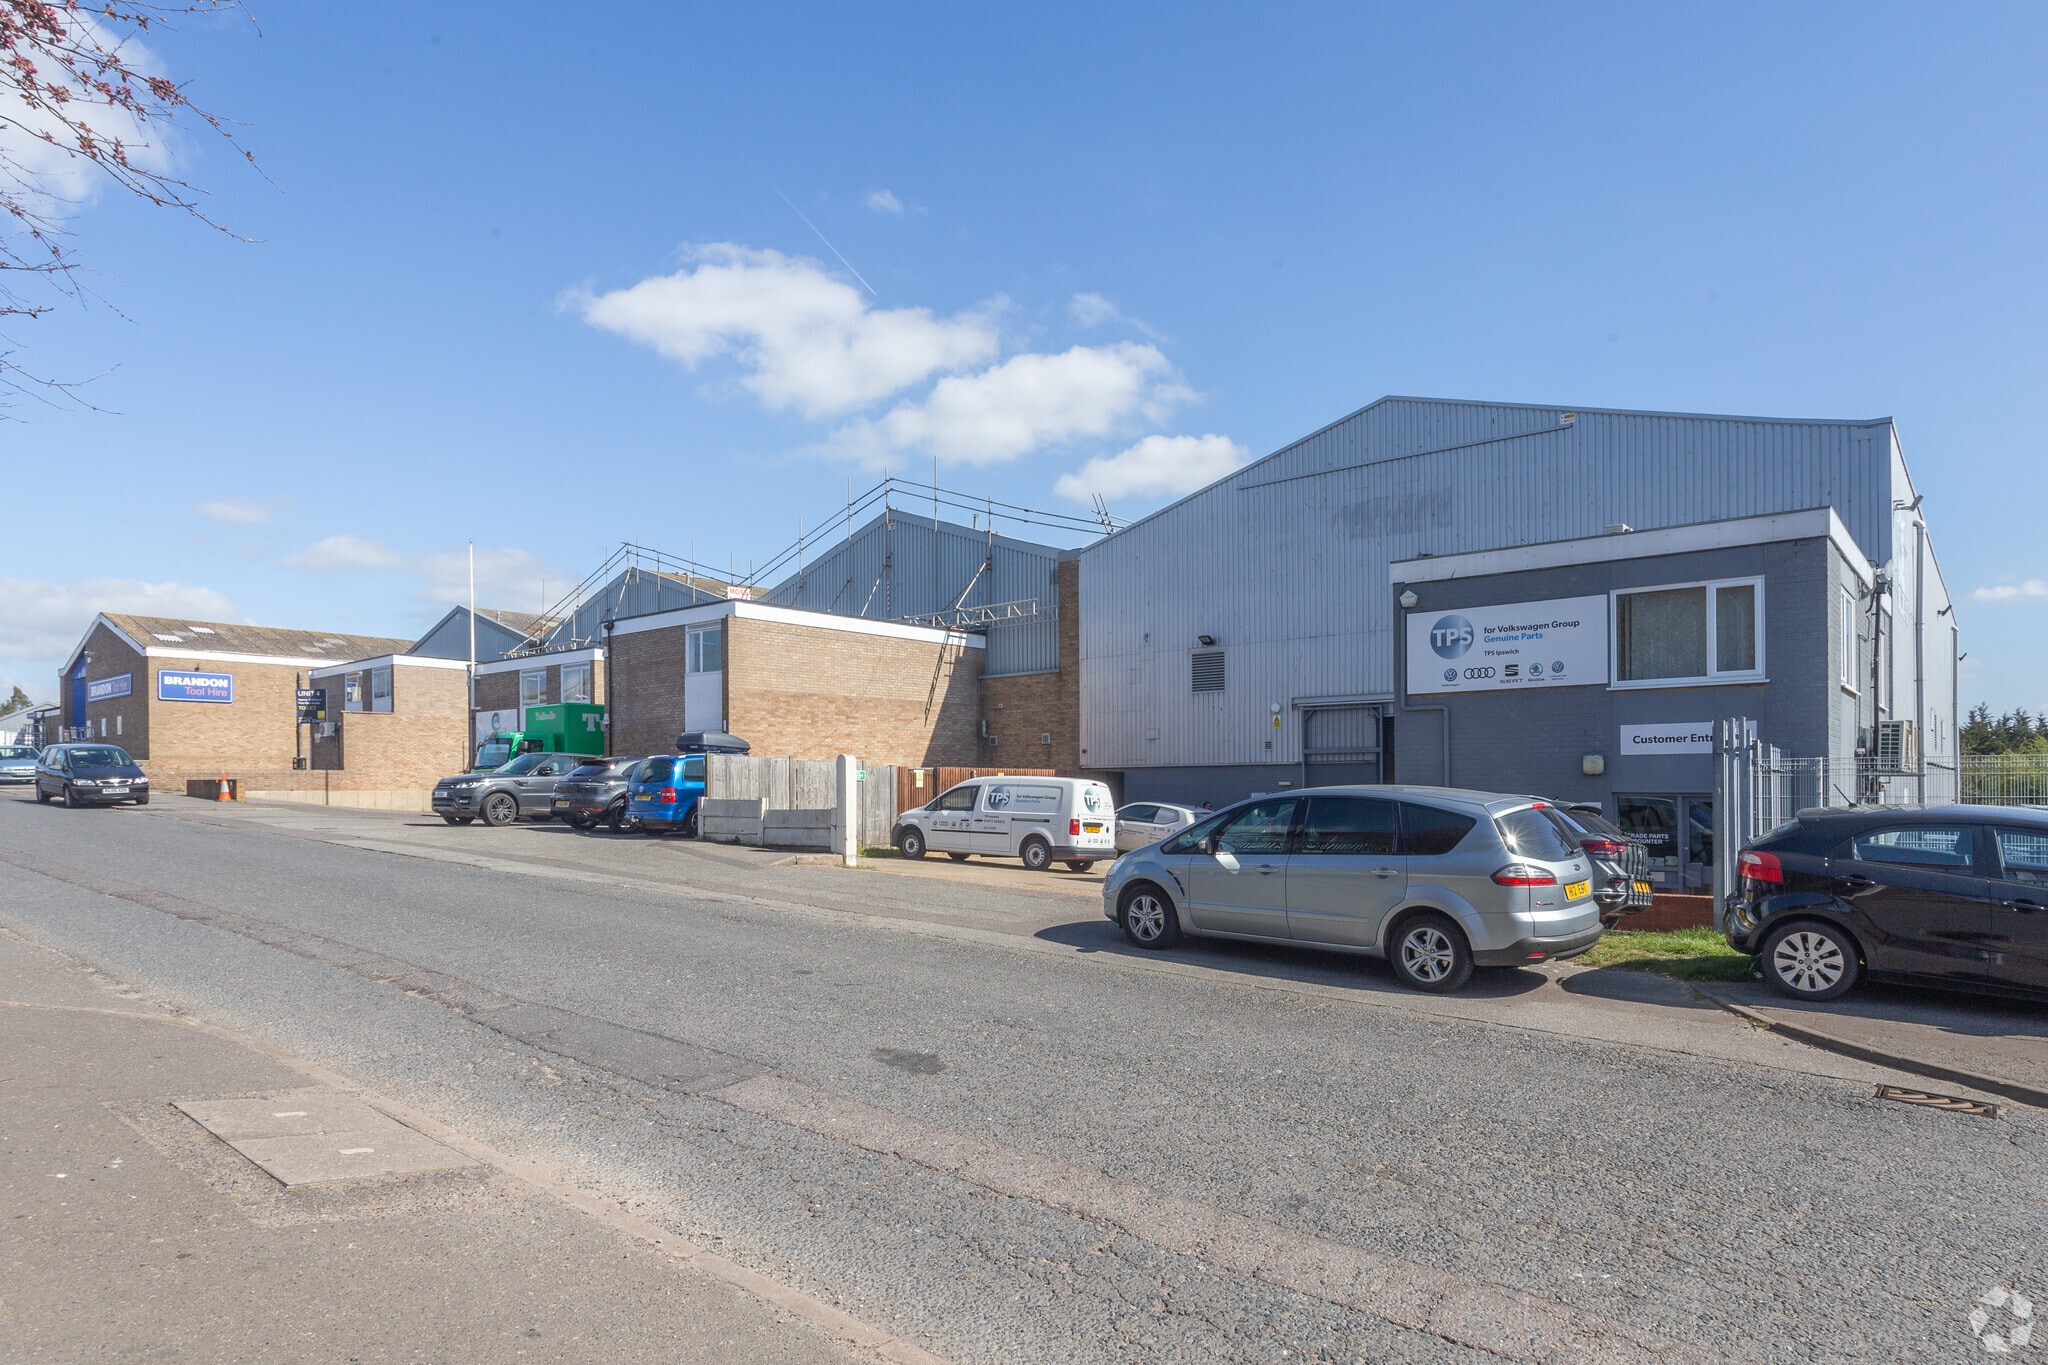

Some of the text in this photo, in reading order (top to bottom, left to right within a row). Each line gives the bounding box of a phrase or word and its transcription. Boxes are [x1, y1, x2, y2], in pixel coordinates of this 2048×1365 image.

[1498, 623, 1549, 632] Volkswagen
[1551, 620, 1580, 629] Group
[1432, 627, 1473, 647] TPS
[1484, 632, 1543, 643] Genuine Parts
[1496, 648, 1519, 656] Ipswich
[163, 675, 228, 688] BRANDON
[184, 686, 227, 697] Tool Hire
[1632, 734, 1688, 744] Customer
[990, 792, 1010, 803] TPS
